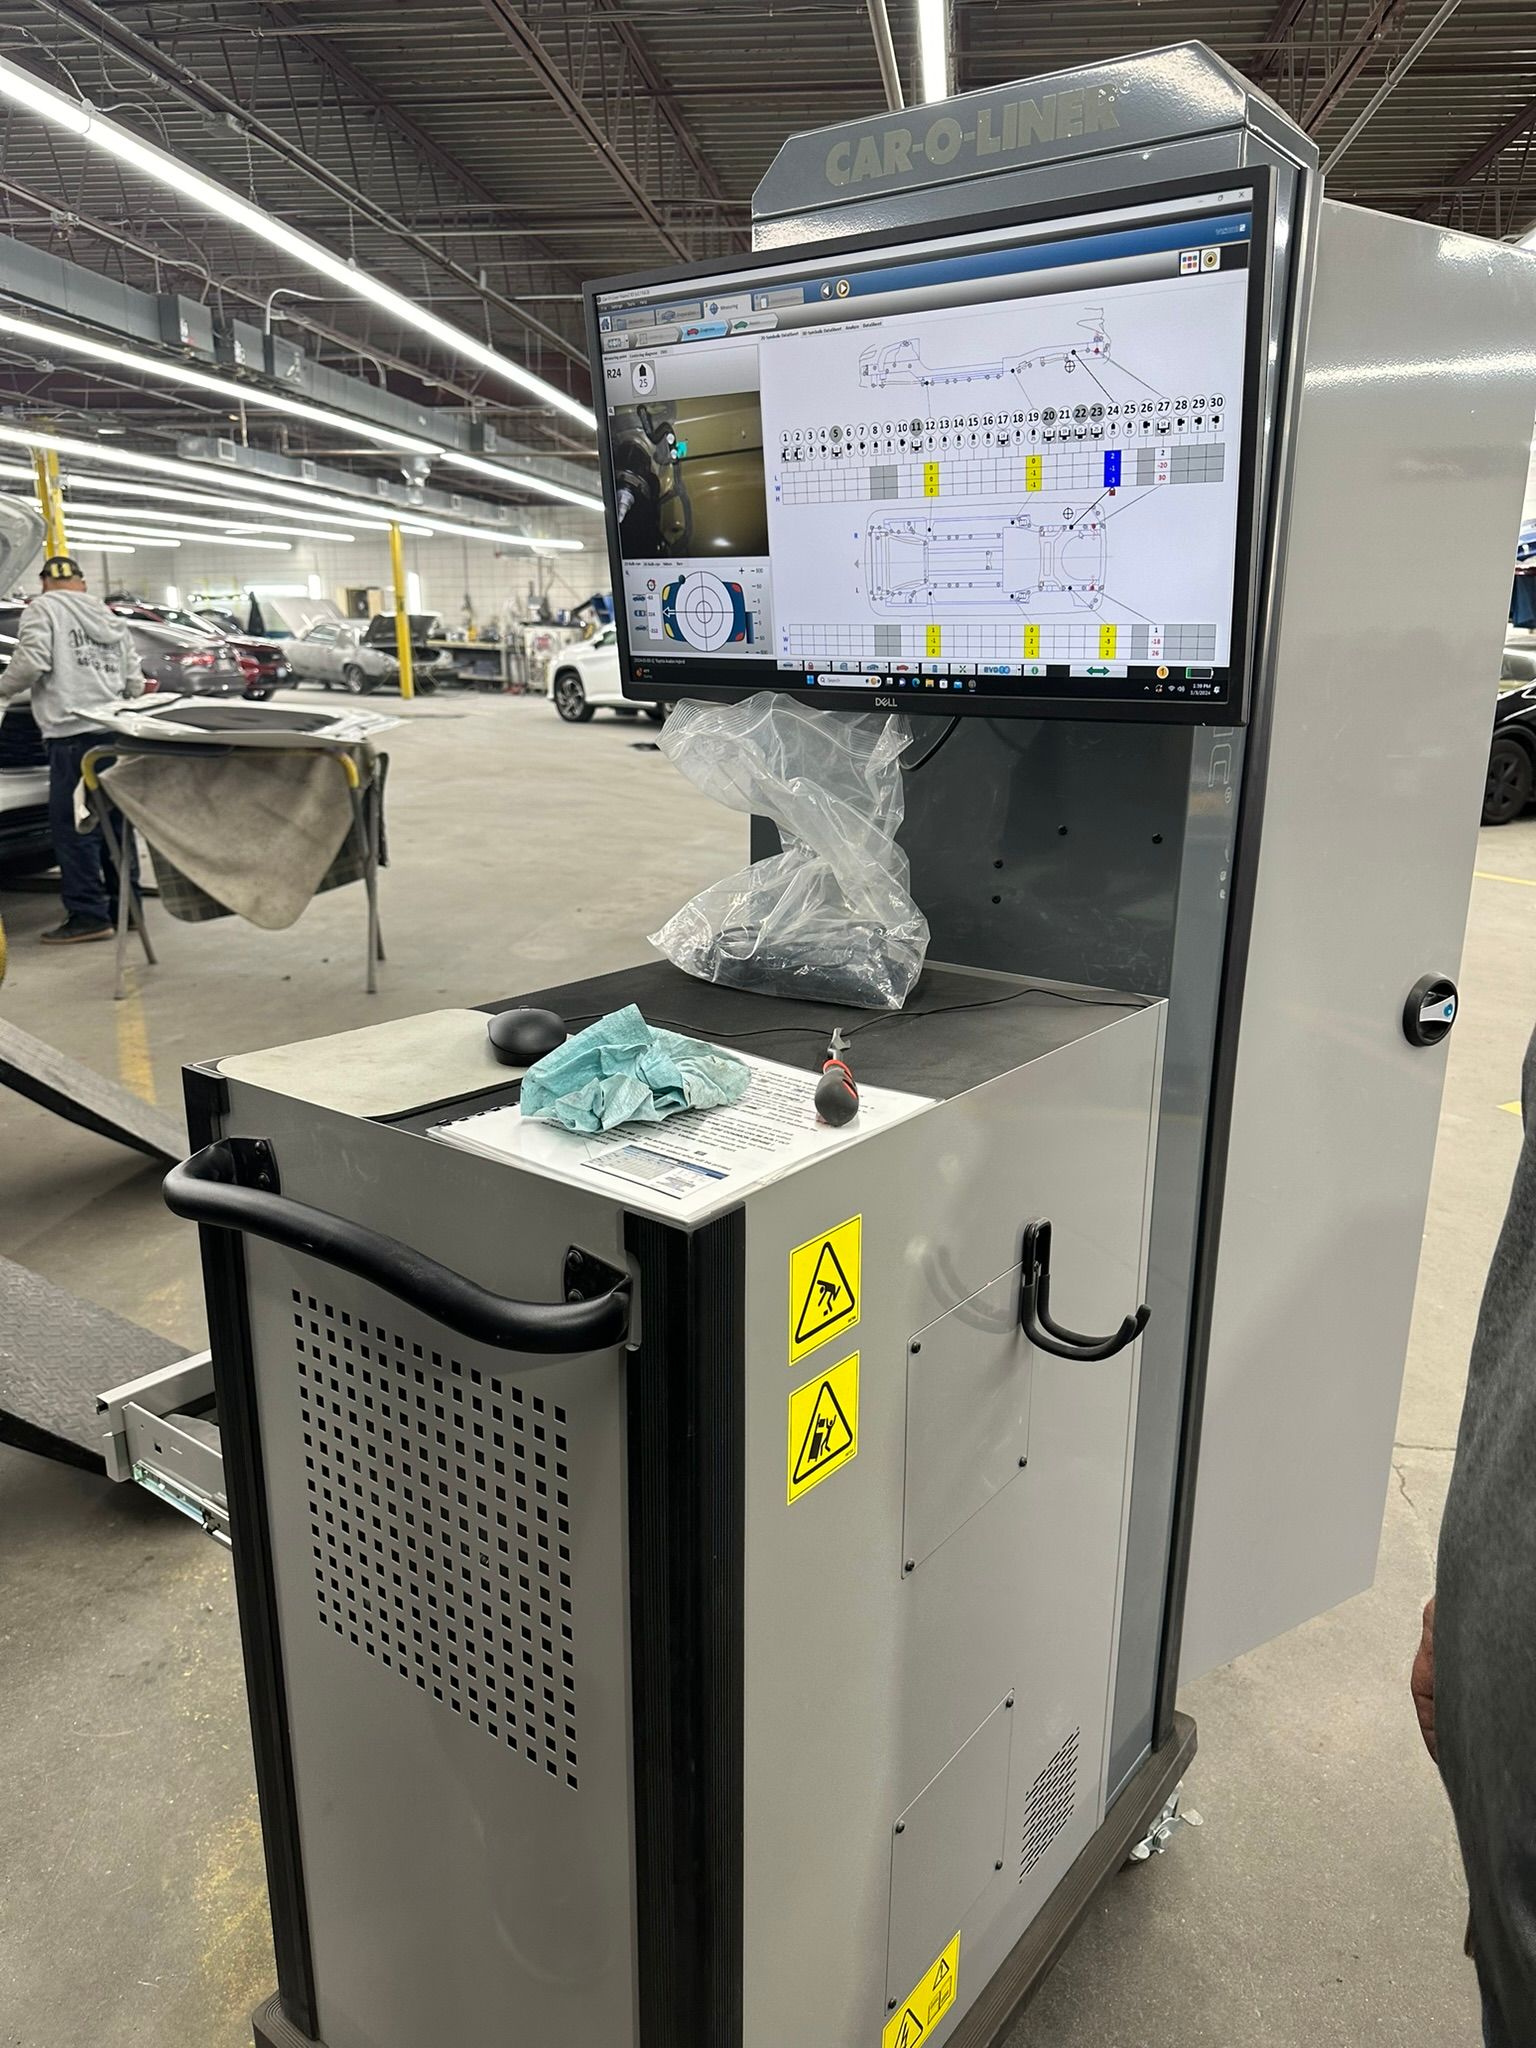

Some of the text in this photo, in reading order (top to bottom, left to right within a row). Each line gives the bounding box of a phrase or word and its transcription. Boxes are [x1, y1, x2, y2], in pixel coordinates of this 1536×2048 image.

[824, 83, 1120, 188] CAR-O-LINER
[606, 368, 622, 379] R24
[639, 378, 648, 388] 25
[898, 423, 908, 432] 10
[911, 422, 921, 431] 11
[926, 421, 935, 430] 12
[940, 420, 949, 429] 13
[954, 419, 964, 428] 14
[968, 417, 978, 427] 15
[983, 416, 994, 425] 16
[998, 415, 1008, 424] 17
[1013, 414, 1024, 423] 18
[1028, 412, 1039, 422] 19
[1044, 411, 1055, 420] 20
[1060, 410, 1070, 419] 21
[1075, 408, 1087, 418] 22
[1091, 407, 1103, 416] 23
[1107, 405, 1119, 416] 24
[1124, 404, 1136, 414] 25
[1141, 403, 1153, 413] 26
[1158, 402, 1170, 411] 27
[1175, 400, 1187, 410] 28
[1192, 399, 1205, 409] 29
[1210, 397, 1223, 407] 30
[875, 697, 898, 707] DELL
